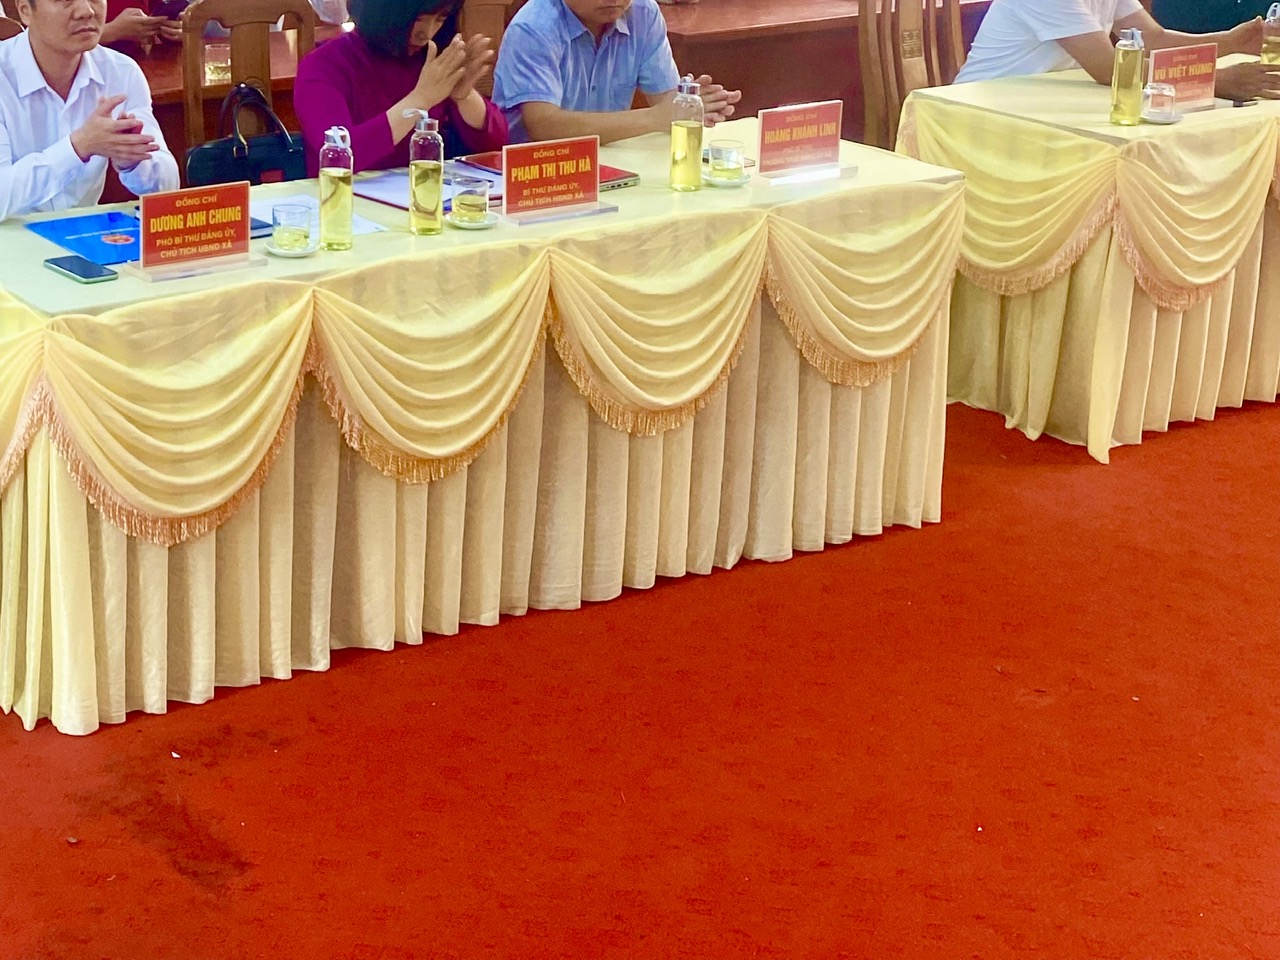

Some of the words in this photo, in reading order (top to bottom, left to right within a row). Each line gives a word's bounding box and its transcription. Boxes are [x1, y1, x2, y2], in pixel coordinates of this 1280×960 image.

[511, 164, 539, 183] PHẠM
[541, 162, 556, 179] THỊ
[559, 160, 576, 176] THU
[578, 155, 591, 172] HÀ
[202, 193, 217, 203] CHÍ
[149, 214, 184, 233] DƯƠNG
[186, 210, 206, 228] ANH
[208, 206, 241, 224] CHUNG
